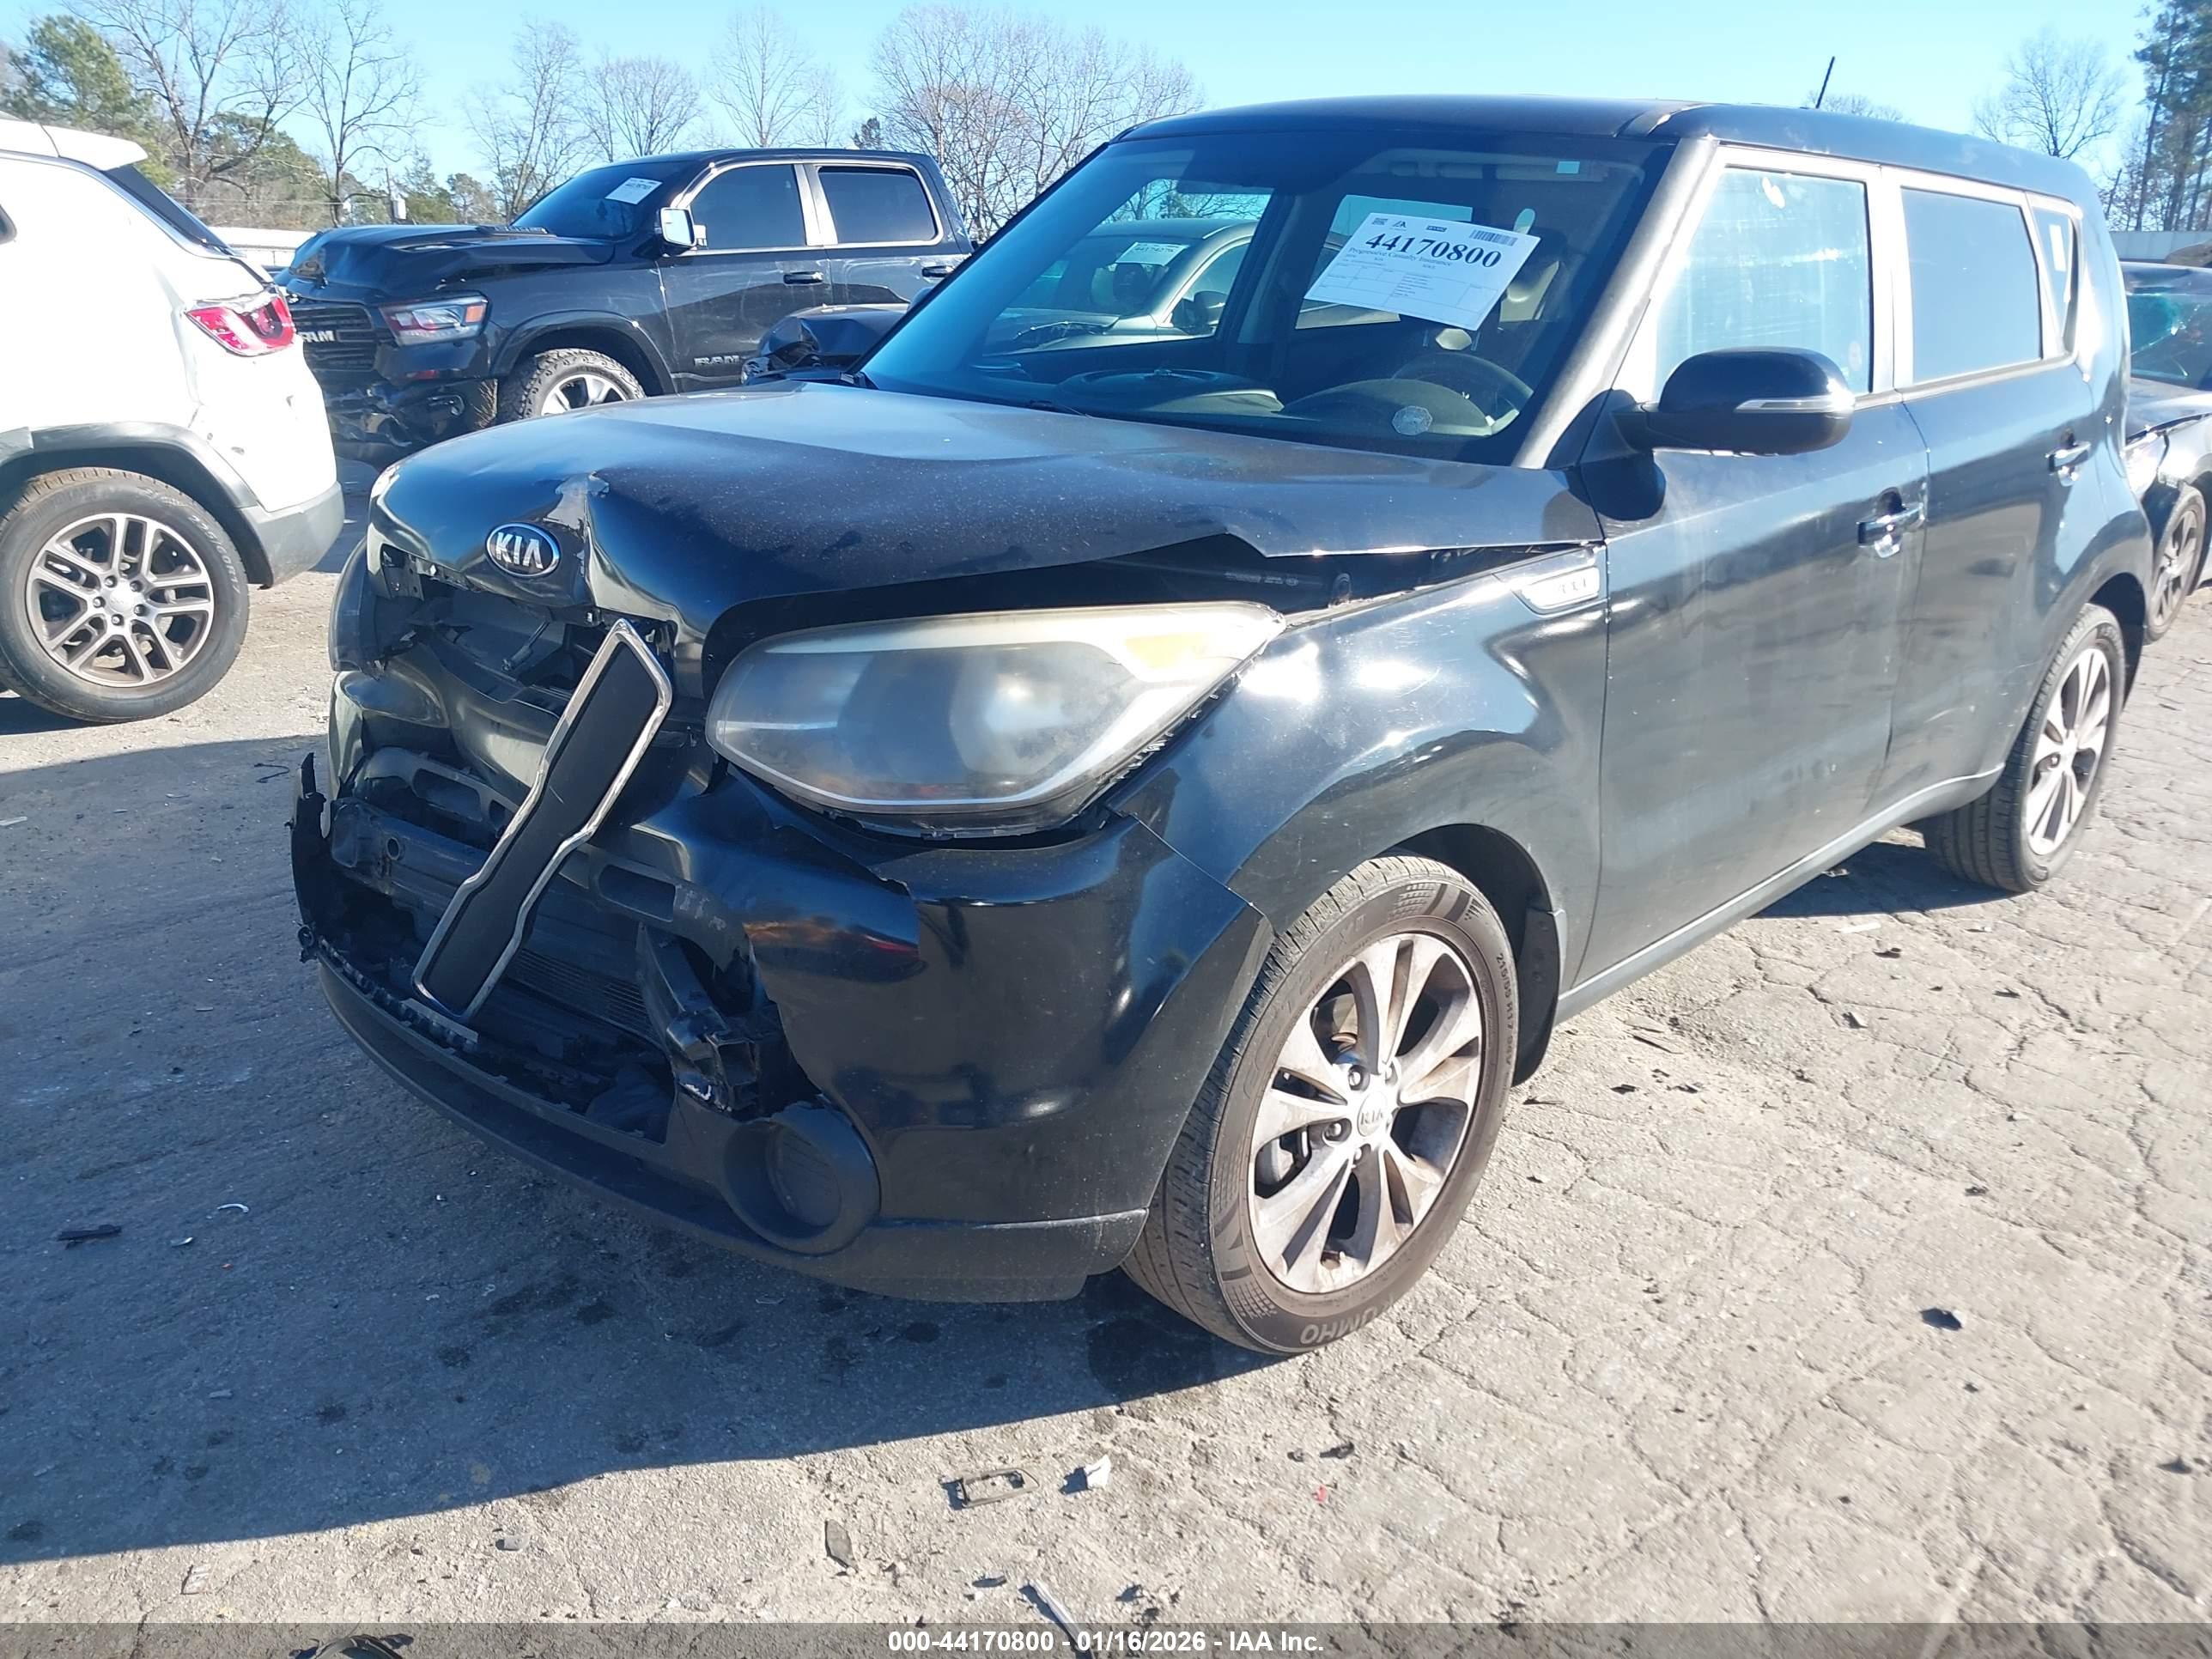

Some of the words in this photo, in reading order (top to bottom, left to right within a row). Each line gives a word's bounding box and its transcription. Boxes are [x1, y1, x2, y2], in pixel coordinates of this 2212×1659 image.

[1365, 233, 1502, 268] 44170800
[298, 331, 335, 343] RAM
[694, 355, 739, 368] RAM
[495, 532, 544, 569] KIA
[1360, 1109, 1383, 1125] KIA
